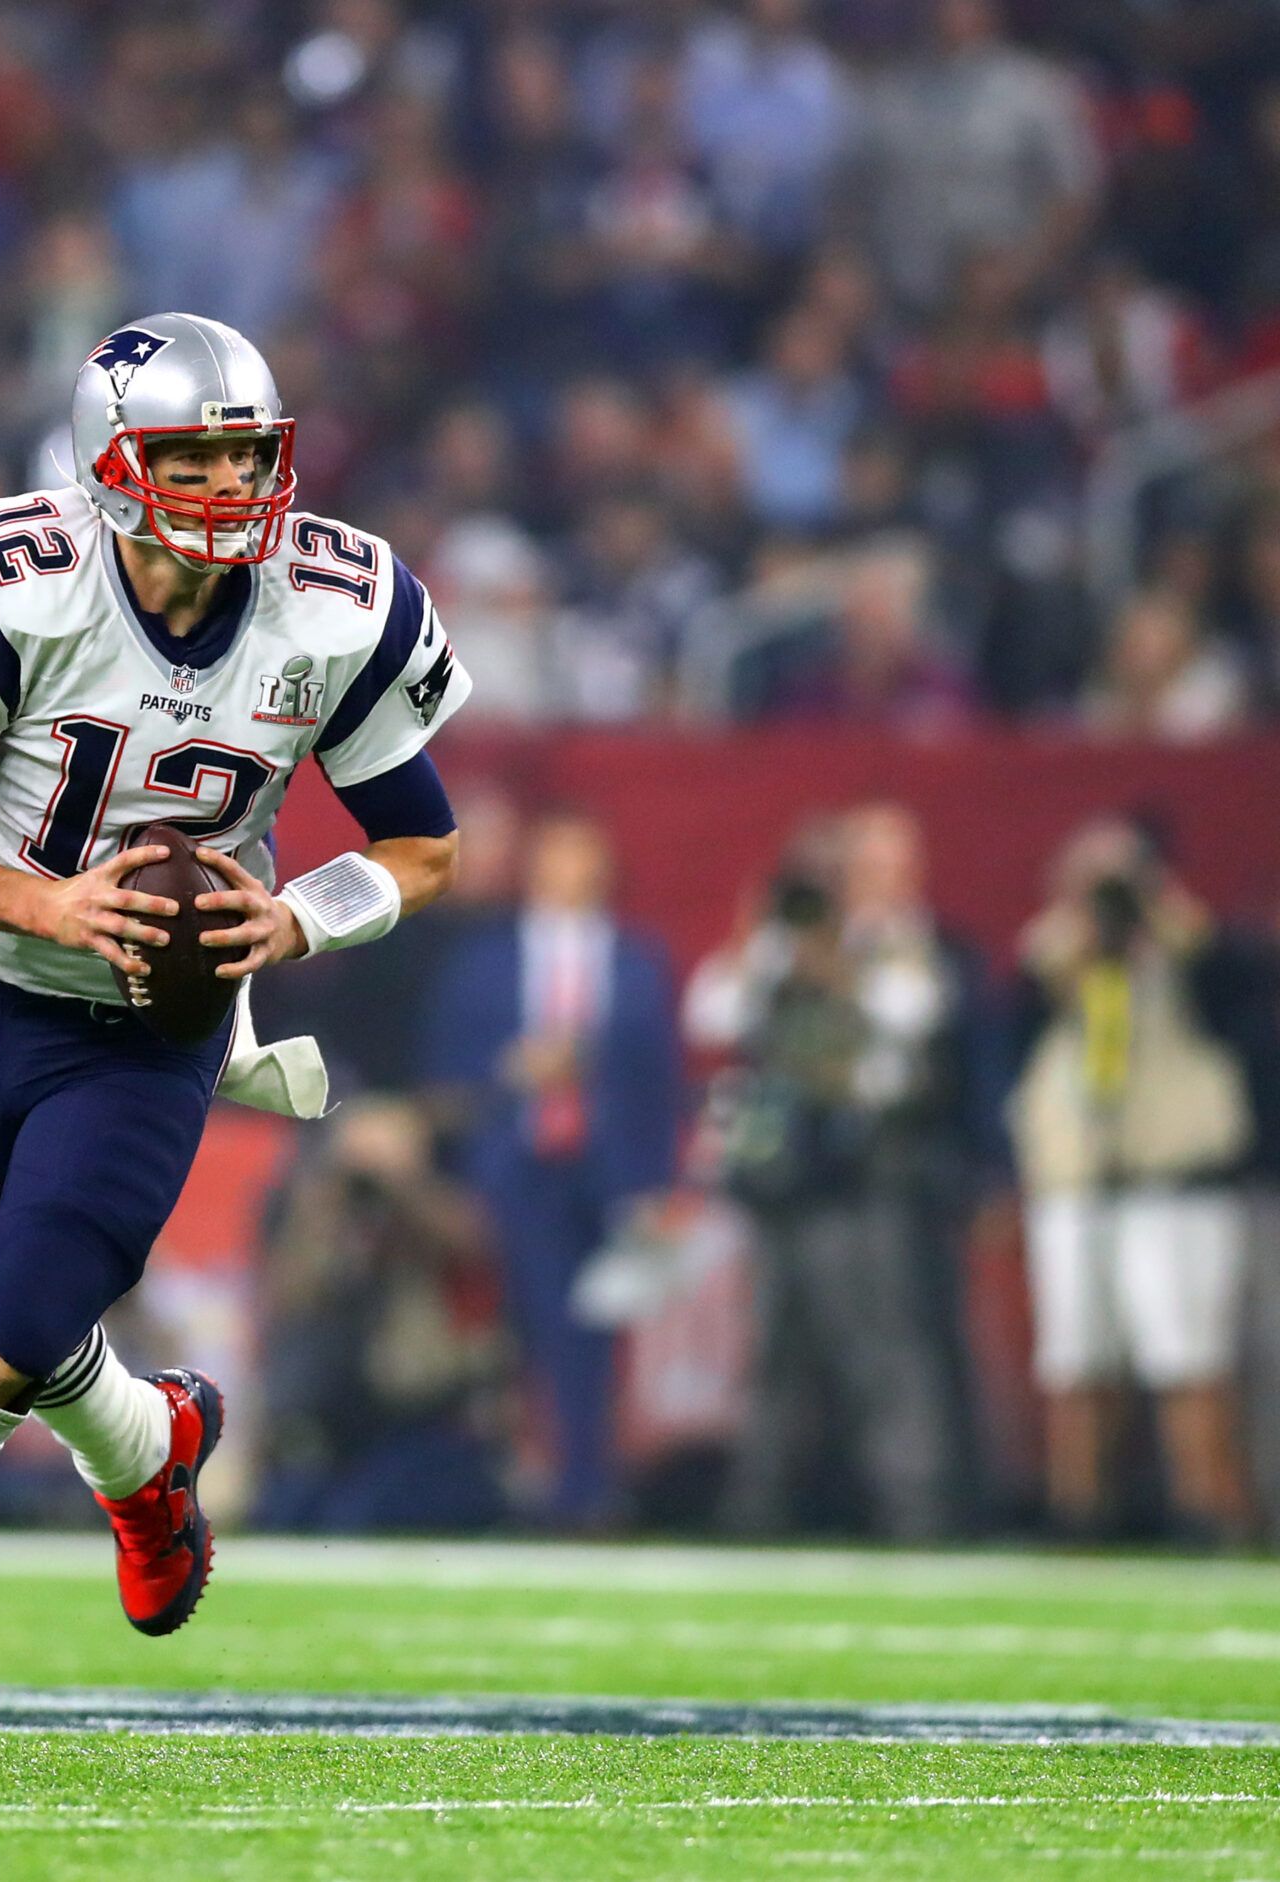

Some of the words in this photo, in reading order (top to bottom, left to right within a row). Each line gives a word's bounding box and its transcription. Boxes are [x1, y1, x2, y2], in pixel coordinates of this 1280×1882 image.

[288, 517, 378, 611] 12
[139, 693, 212, 722] PATRIOTS
[173, 678, 192, 692] NFL
[18, 714, 277, 881] 12
